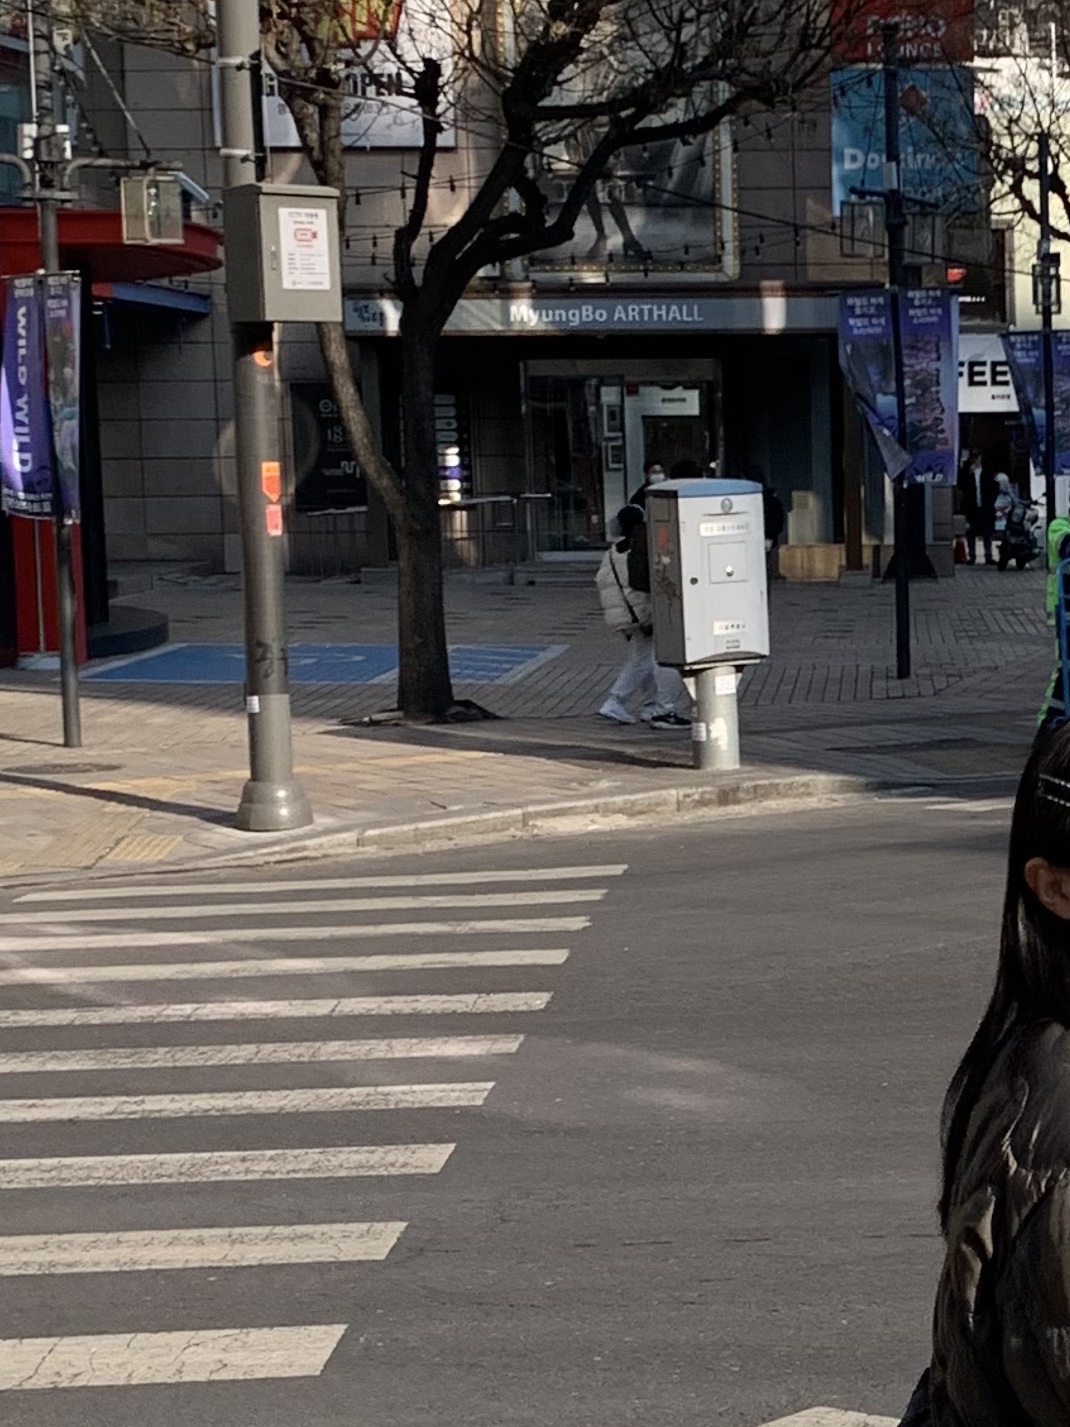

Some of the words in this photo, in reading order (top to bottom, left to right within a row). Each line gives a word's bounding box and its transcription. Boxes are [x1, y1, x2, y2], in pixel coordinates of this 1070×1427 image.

[16, 306, 28, 386] WILD
[510, 304, 607, 327] MyungBo
[613, 304, 704, 323] ARTHALL
[13, 398, 33, 474] WILD
